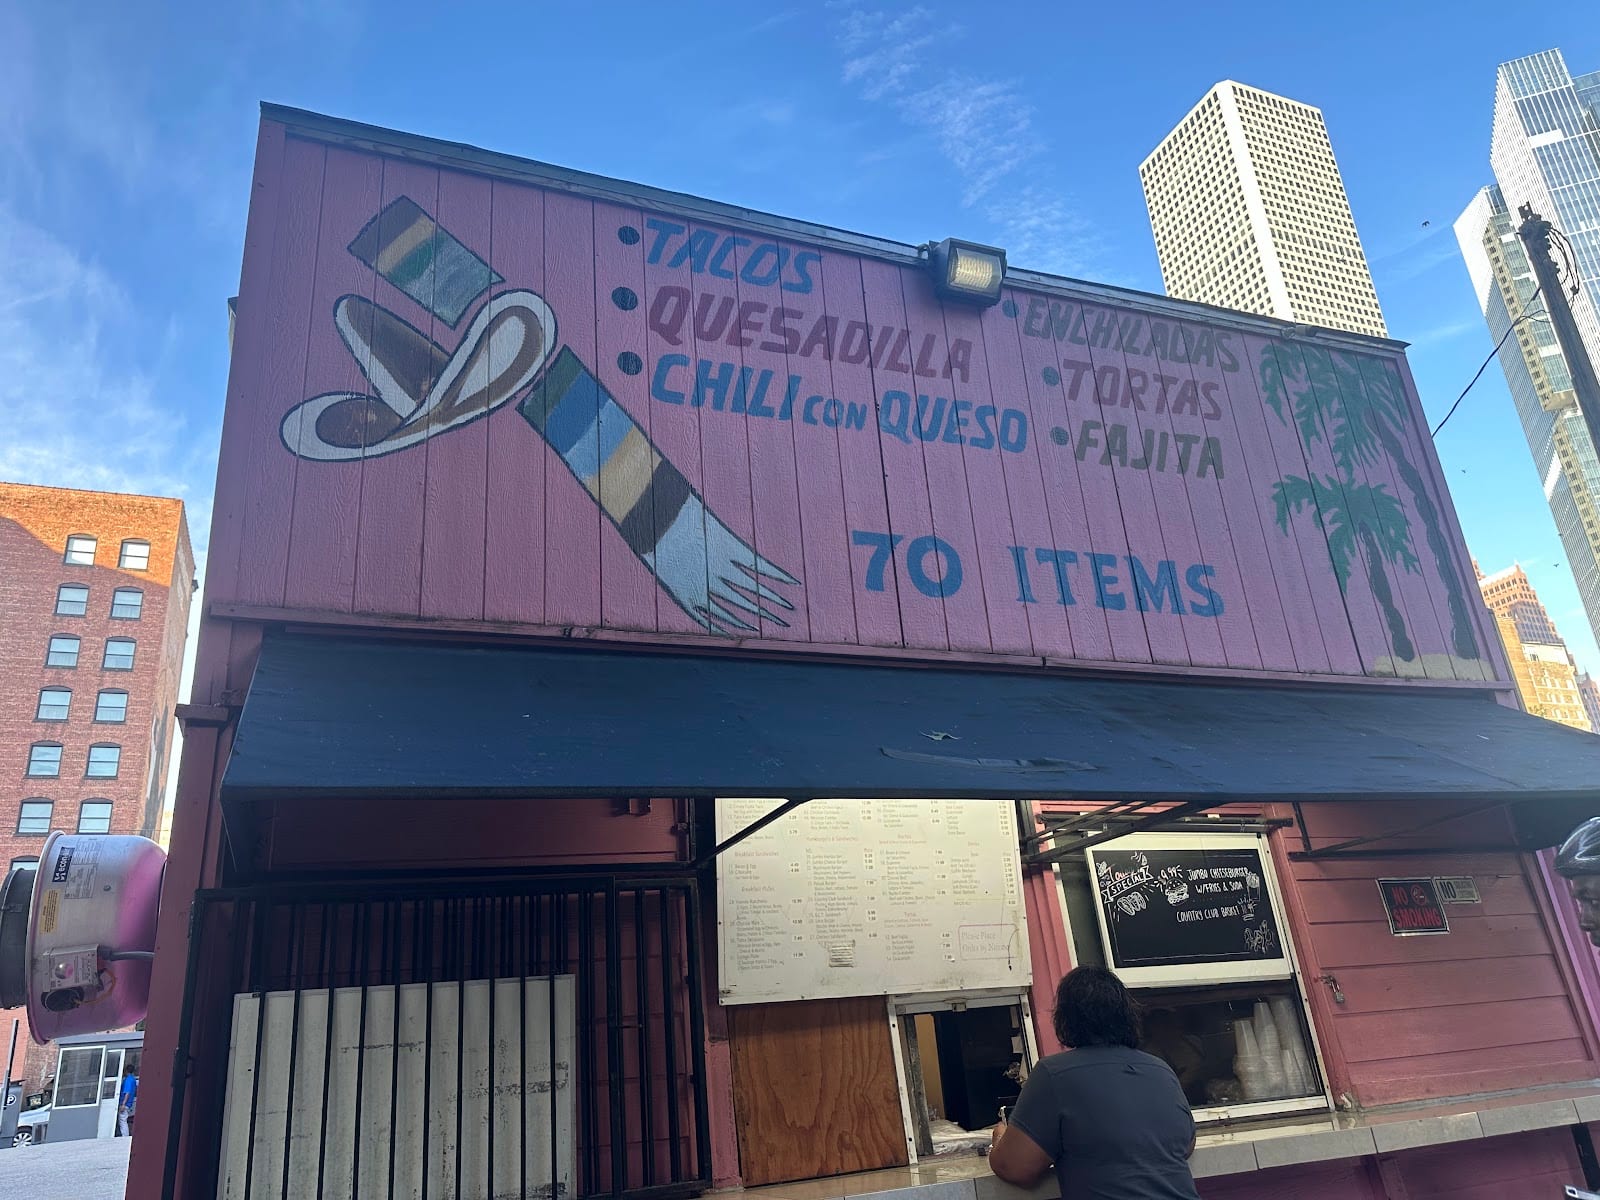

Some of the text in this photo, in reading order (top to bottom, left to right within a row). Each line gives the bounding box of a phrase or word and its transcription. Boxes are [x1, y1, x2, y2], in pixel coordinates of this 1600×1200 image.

[646, 217, 824, 294] TACOS
[649, 285, 973, 384] QUESADILLA
[1022, 297, 1240, 373] ENCHILADAS
[651, 353, 1028, 453] CHILI CON QUESO
[1063, 358, 1222, 421] TORTAS
[1075, 419, 1225, 479] FAJITA
[852, 530, 1225, 618] 70 ITEMS
[1111, 872, 1144, 894] SPECIAL
[1187, 867, 1250, 881] JUMBO CHEESEBURGER
[1391, 886, 1409, 905] NO
[1440, 881, 1457, 899] NO
[1177, 910, 1204, 922] COUNTRY
[1204, 908, 1220, 919] CLUB
[1221, 905, 1240, 917] BASKET
[1392, 907, 1443, 928] SMOKING
